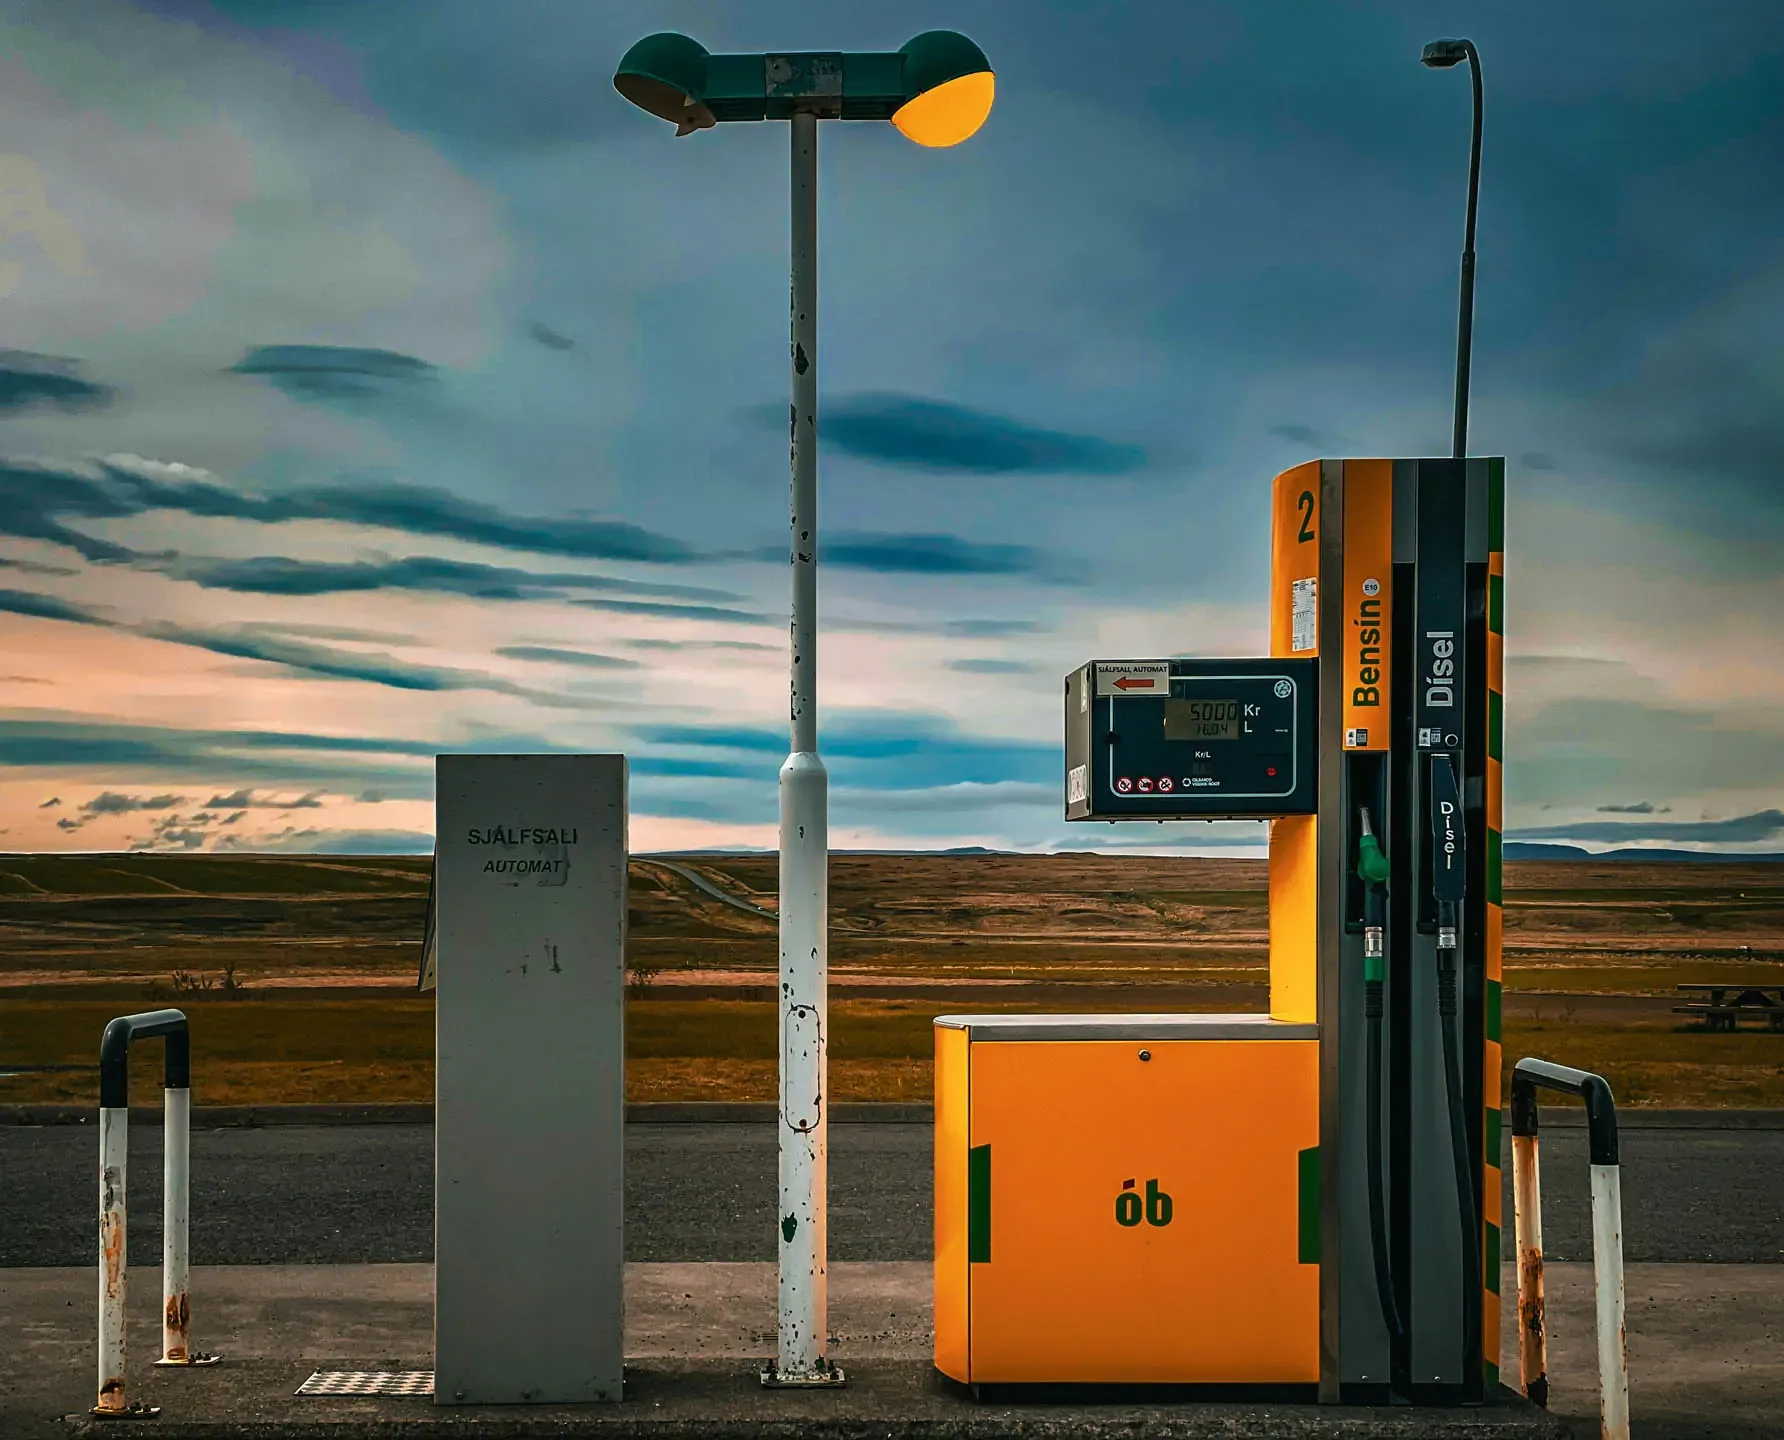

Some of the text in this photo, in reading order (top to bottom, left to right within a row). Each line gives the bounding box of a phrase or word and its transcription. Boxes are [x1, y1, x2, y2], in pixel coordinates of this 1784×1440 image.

[1298, 490, 1315, 544] 2
[1353, 600, 1381, 706] Bensín
[1426, 631, 1454, 707] Dísel
[1190, 703, 1237, 721] 5000
[1244, 704, 1261, 717] Kr
[1244, 720, 1253, 733] L
[467, 825, 578, 845] SJÁLFSALI
[483, 859, 562, 873] AUTOMAT
[1115, 1178, 1173, 1227] ób
